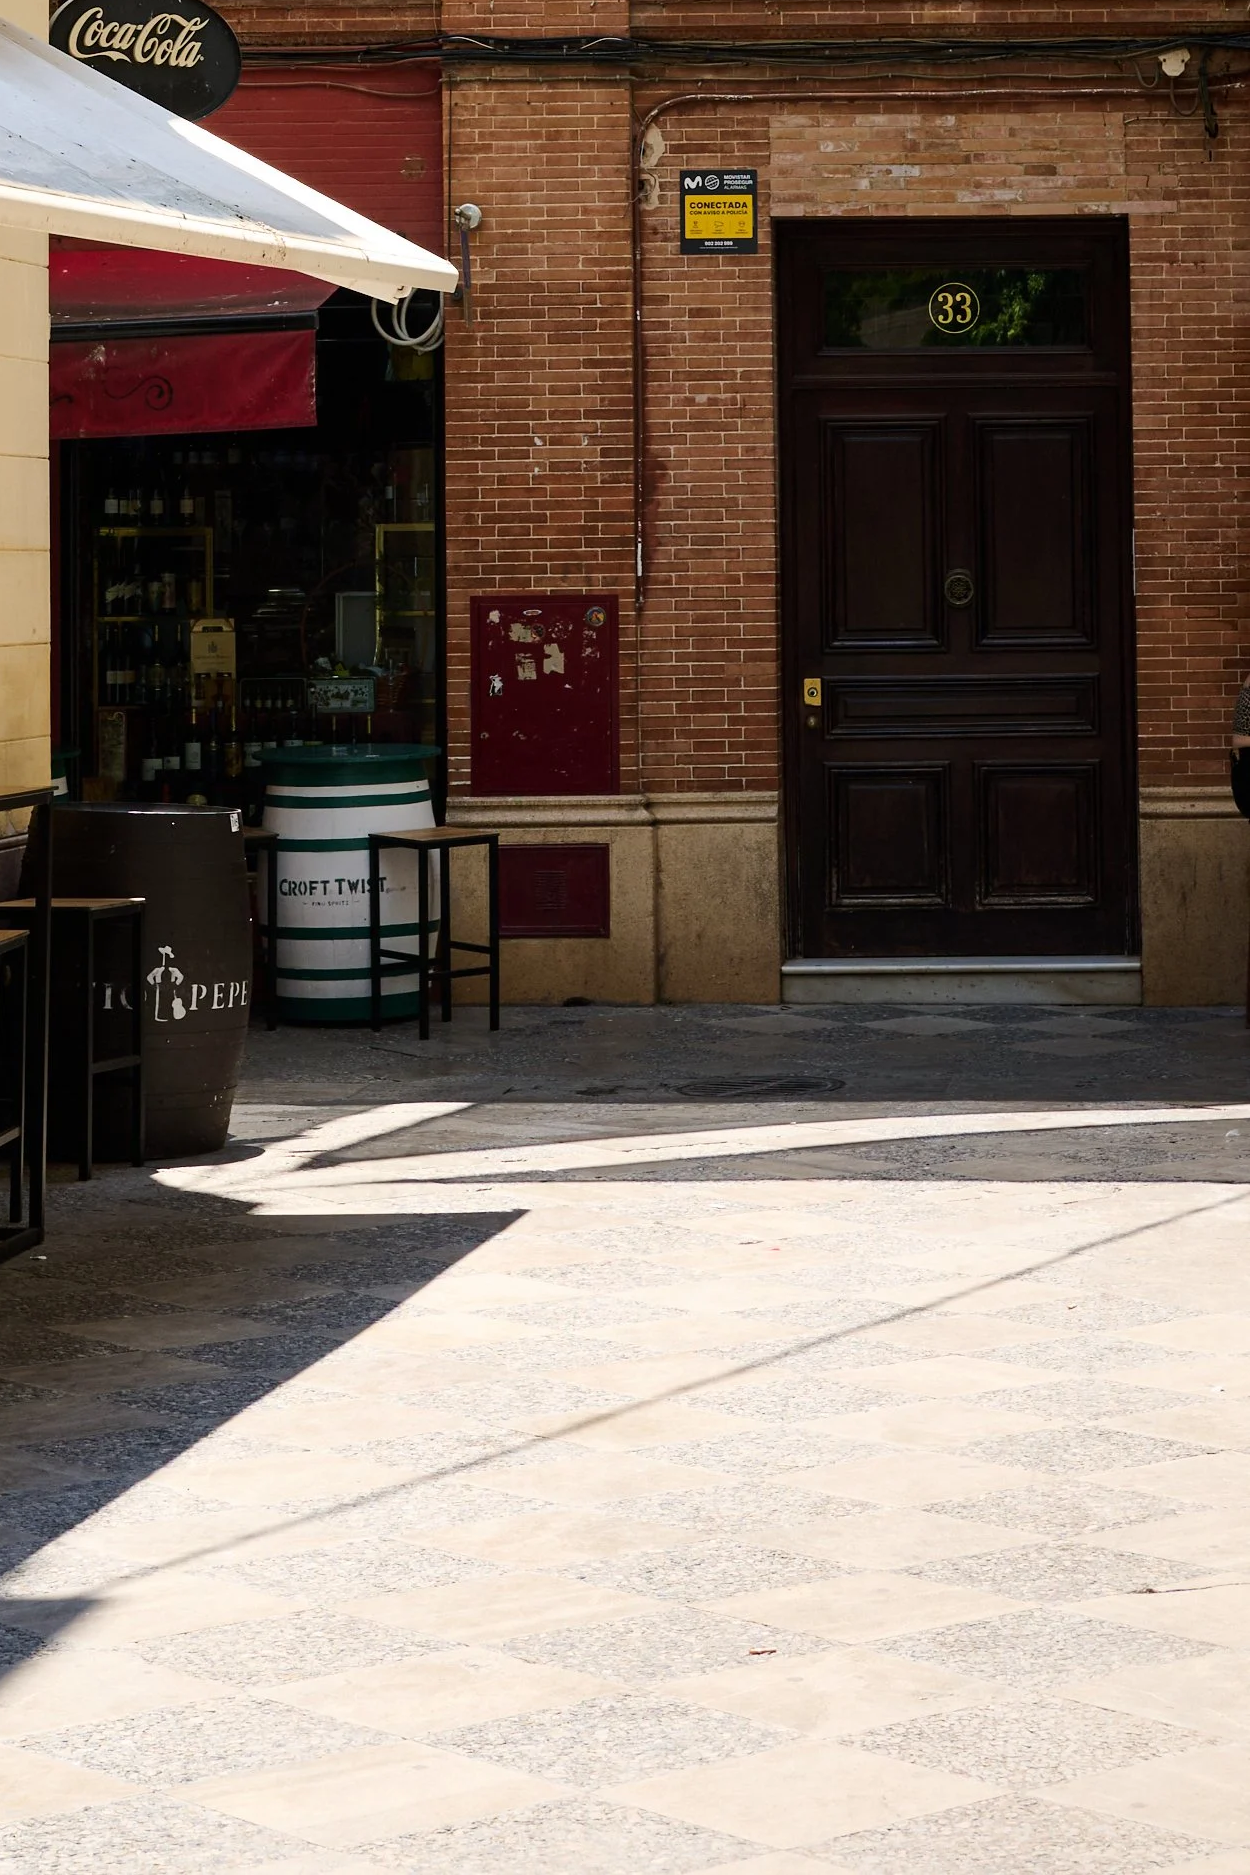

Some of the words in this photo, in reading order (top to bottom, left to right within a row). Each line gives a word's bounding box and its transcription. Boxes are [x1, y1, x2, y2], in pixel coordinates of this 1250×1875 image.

[68, 6, 210, 68] Coca-Cola
[937, 292, 972, 324] 33
[278, 877, 330, 896] CROFT
[189, 980, 249, 1011] PEPE
